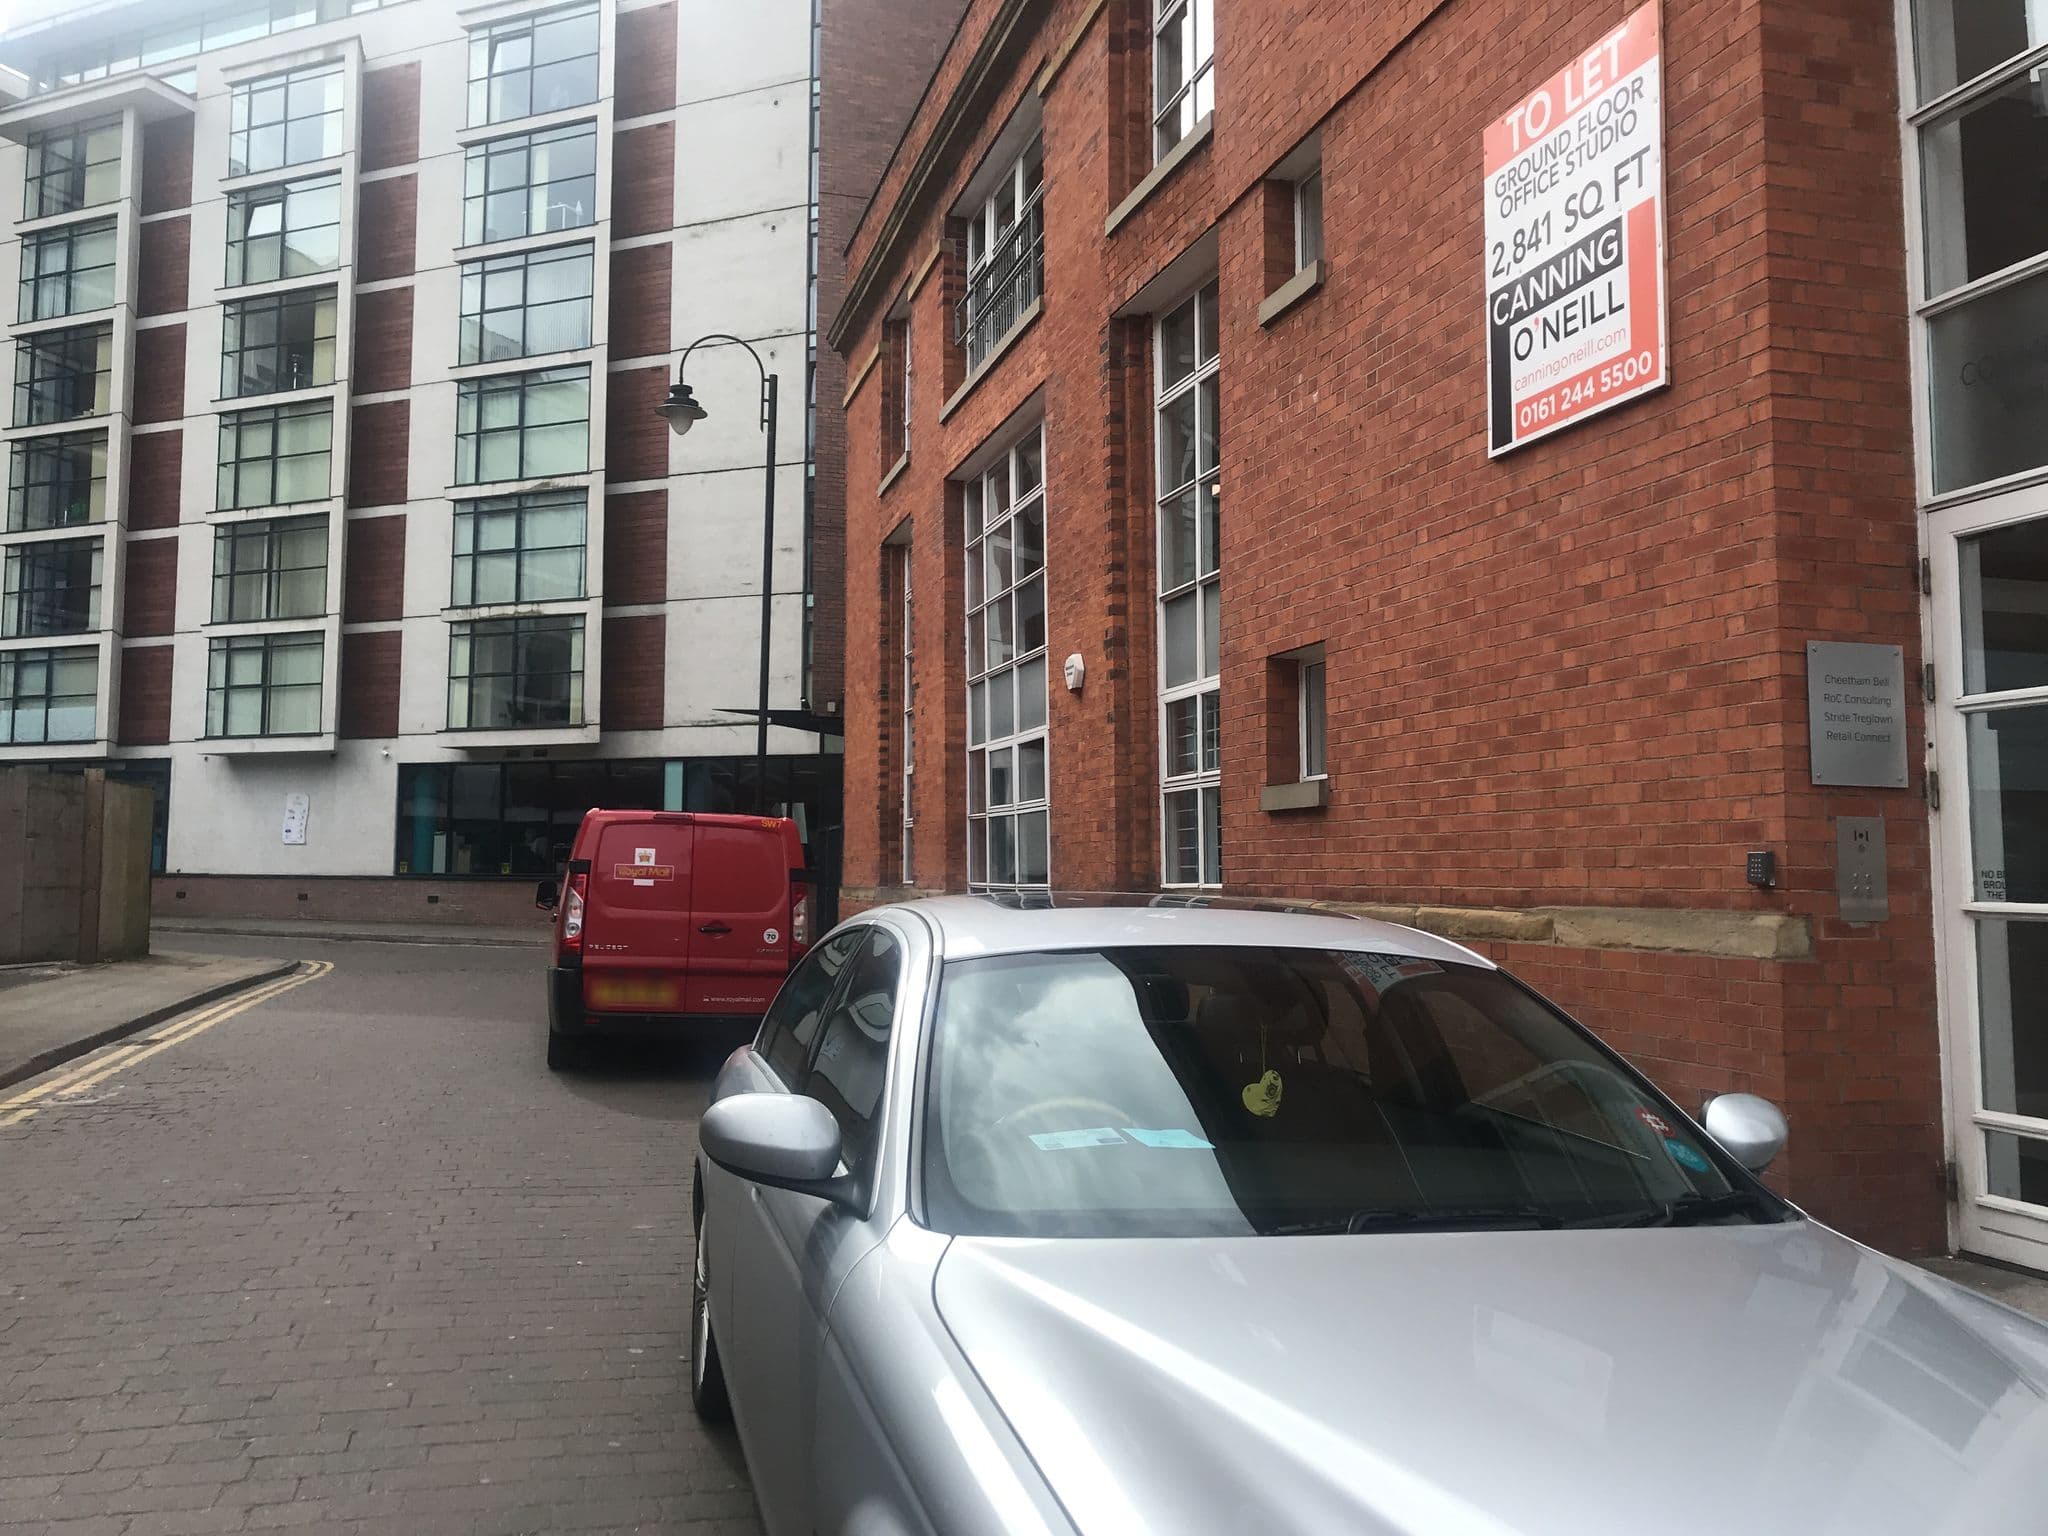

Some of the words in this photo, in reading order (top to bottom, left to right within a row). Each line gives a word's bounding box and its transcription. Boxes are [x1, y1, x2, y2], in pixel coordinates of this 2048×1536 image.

[1506, 90, 1551, 153] TO
[1564, 26, 1630, 115] LET
[1495, 129, 1571, 198] GROUND
[1578, 76, 1644, 142] FLOOR
[1500, 161, 1560, 219] OFFICE
[1565, 109, 1637, 176] STUDIO
[1493, 210, 1550, 278] 2,841
[1564, 180, 1604, 233] SQ
[1614, 144, 1651, 203] FT
[1493, 228, 1618, 326] CANNING
[1514, 281, 1625, 361] O'NEILL
[1514, 327, 1627, 392] canningoneill.com
[1520, 394, 1555, 428] 0161
[1561, 376, 1595, 410] 244
[1601, 350, 1652, 393] 5500
[1824, 674, 1870, 686] Cheetham
[1844, 694, 1892, 707] Consulting
[1824, 711, 1850, 722] Stride
[1853, 713, 1893, 725] Treglown
[1826, 731, 1852, 742] Retail
[1854, 732, 1891, 743] Connect
[619, 866, 646, 877] Royal
[648, 867, 671, 877] Mail
[1981, 870, 1994, 879] NO
[1986, 890, 2004, 899] THE
